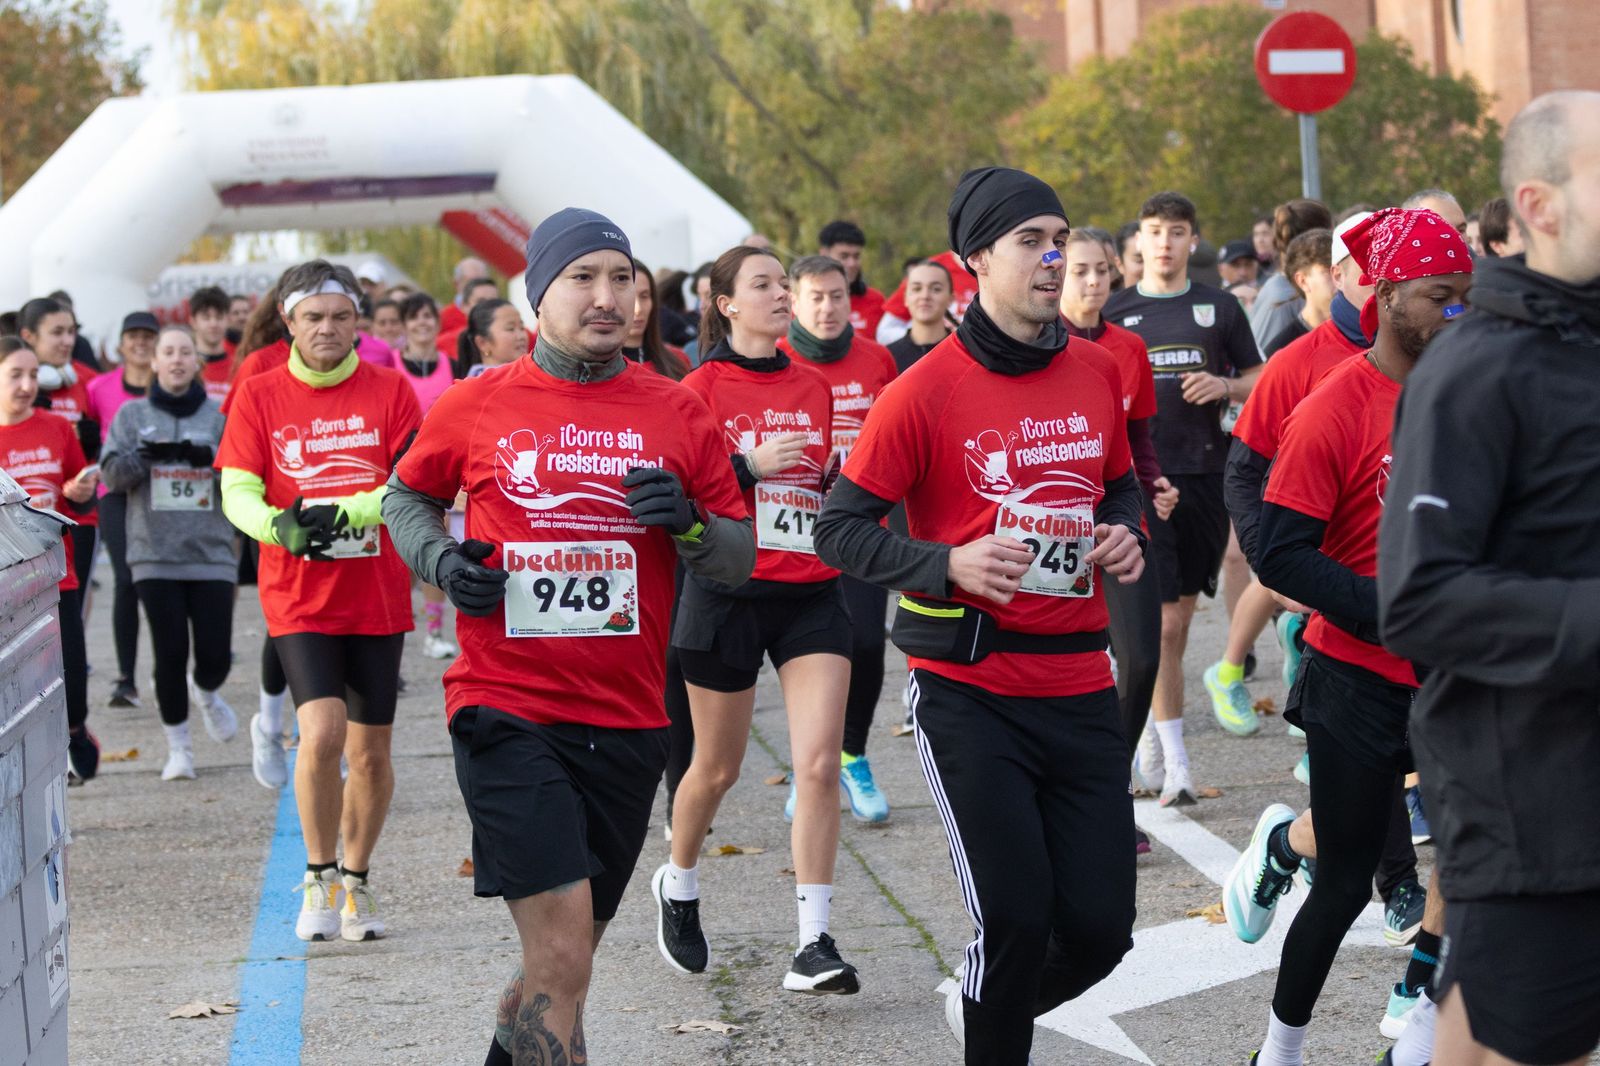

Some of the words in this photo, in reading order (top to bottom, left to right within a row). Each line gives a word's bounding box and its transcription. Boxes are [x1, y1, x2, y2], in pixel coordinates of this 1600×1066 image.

[311, 418, 346, 436] ¡Corre
[346, 414, 365, 430] sin
[763, 408, 796, 428] ¡Corre
[795, 409, 812, 426] sin
[1019, 417, 1066, 442] ¡Corre
[1067, 412, 1089, 433] sin
[305, 428, 380, 454] resistencias!
[560, 423, 614, 448] ¡Corre
[617, 428, 643, 451] sin
[1015, 433, 1103, 468] resistencias!
[171, 481, 194, 497] 56
[774, 509, 818, 536] 417
[1000, 507, 1093, 538] bedunia
[507, 548, 634, 573] bedunia
[533, 576, 610, 613] 948
